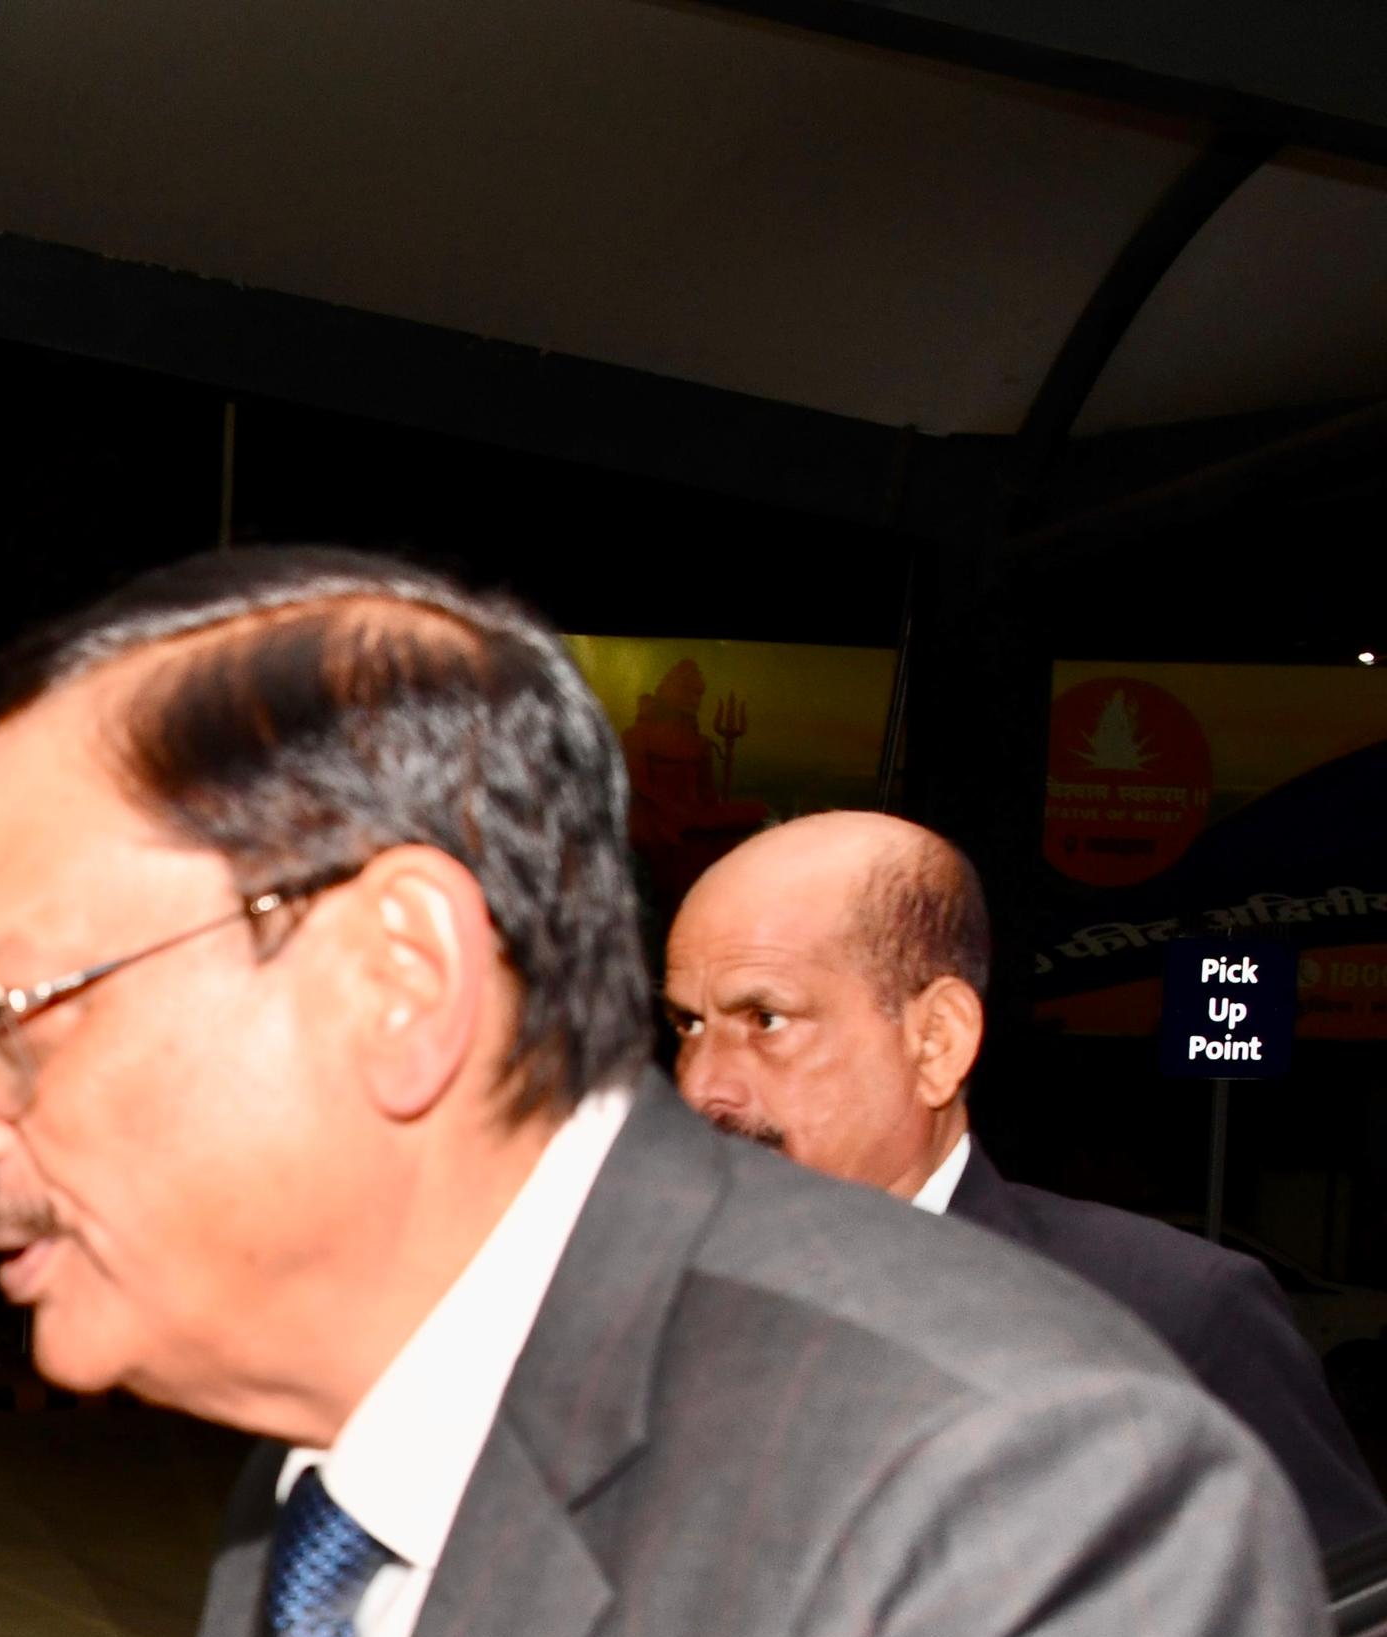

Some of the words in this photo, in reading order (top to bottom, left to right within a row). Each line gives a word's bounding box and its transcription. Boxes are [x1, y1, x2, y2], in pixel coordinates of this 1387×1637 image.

[1201, 956, 1259, 984] Pick
[1208, 997, 1247, 1030] Up
[1188, 1033, 1262, 1061] Point
